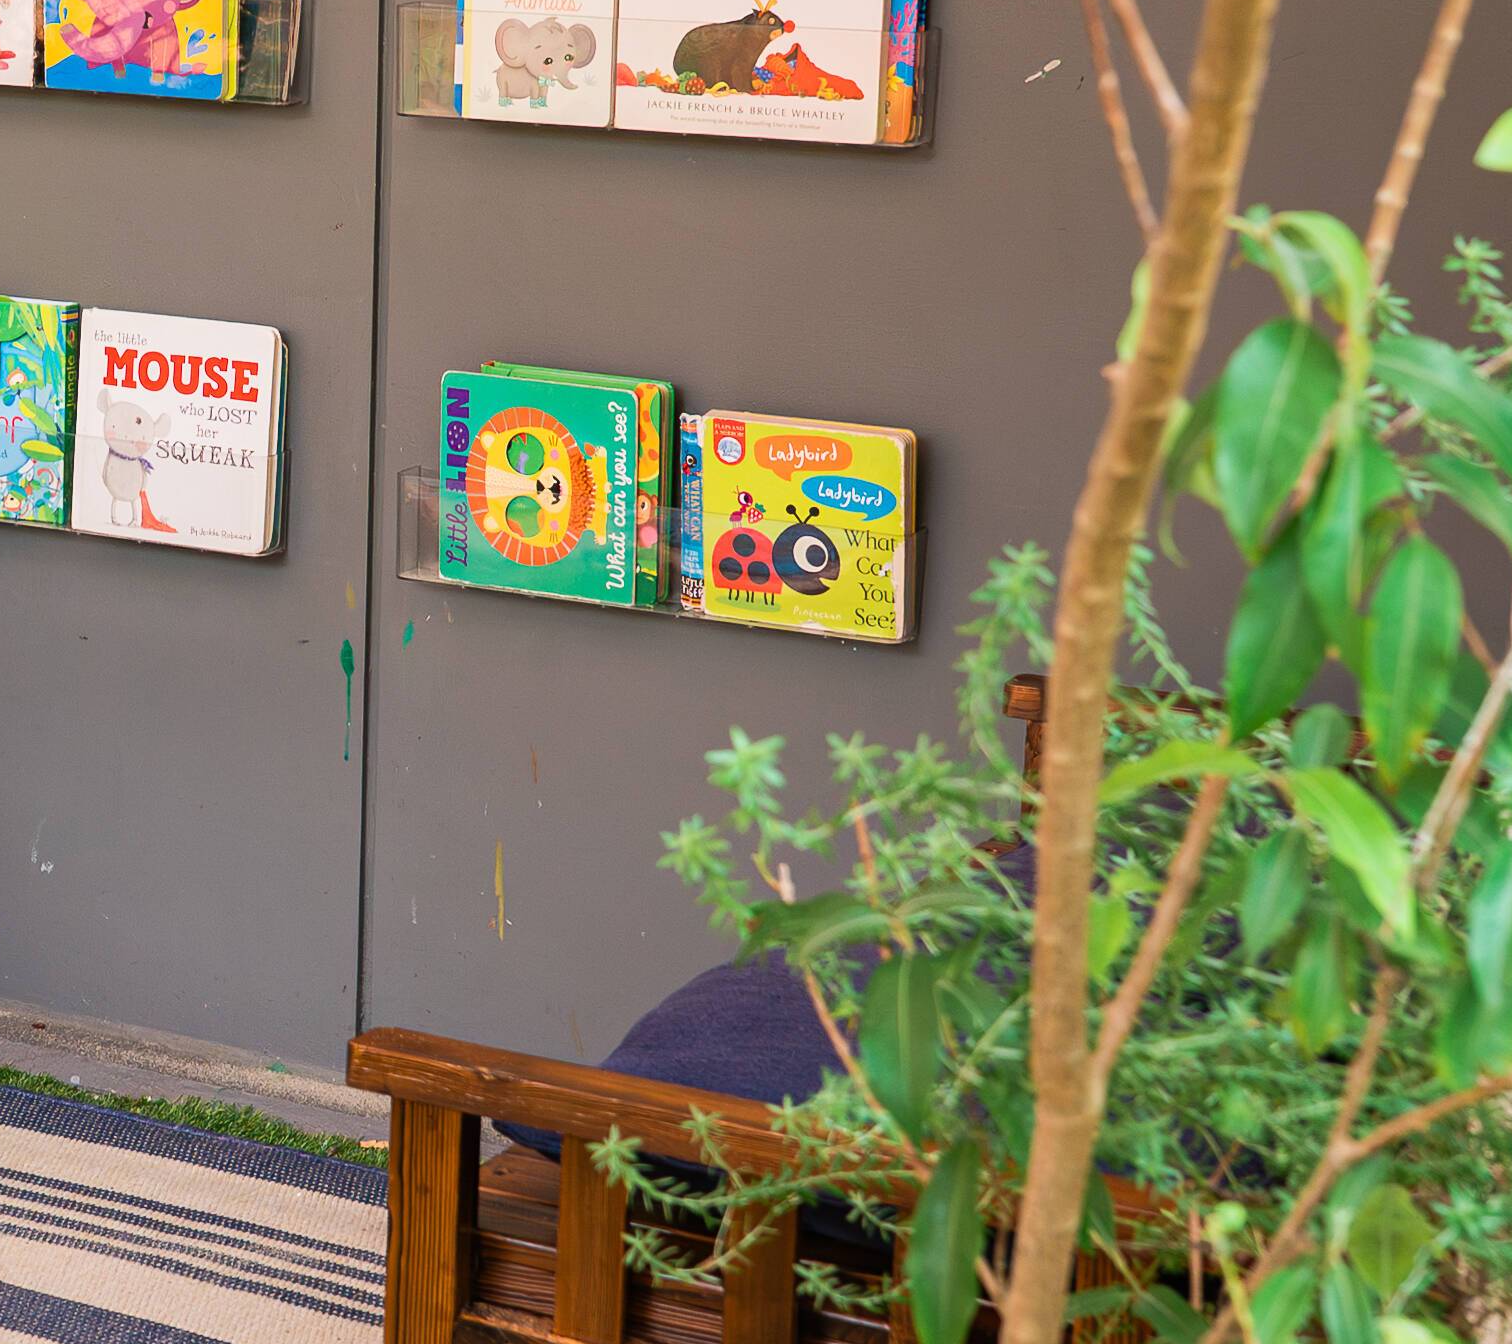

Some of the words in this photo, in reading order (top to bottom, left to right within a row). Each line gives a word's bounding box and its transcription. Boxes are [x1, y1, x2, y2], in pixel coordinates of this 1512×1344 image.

[647, 99, 682, 111] JACKIE
[687, 102, 732, 113] FRENCH
[749, 106, 786, 117] BRUCE
[791, 109, 847, 121] WHATLEY
[94, 330, 113, 342] the
[117, 332, 148, 346] little
[66, 354, 77, 407] Jungle
[103, 346, 259, 403] MOUSE
[179, 403, 205, 416] who
[208, 406, 257, 425] LOST
[607, 401, 628, 444] see?
[196, 424, 219, 439] her
[446, 387, 470, 493] LION
[156, 439, 255, 470] SQUEAK
[613, 448, 632, 487] you
[768, 442, 837, 469] Ladybird
[613, 490, 627, 527] can
[818, 480, 883, 508] Ladybird
[446, 501, 468, 567] Little
[844, 528, 895, 553] What
[605, 531, 626, 590] What
[859, 582, 895, 604] You
[854, 607, 896, 630] See?
